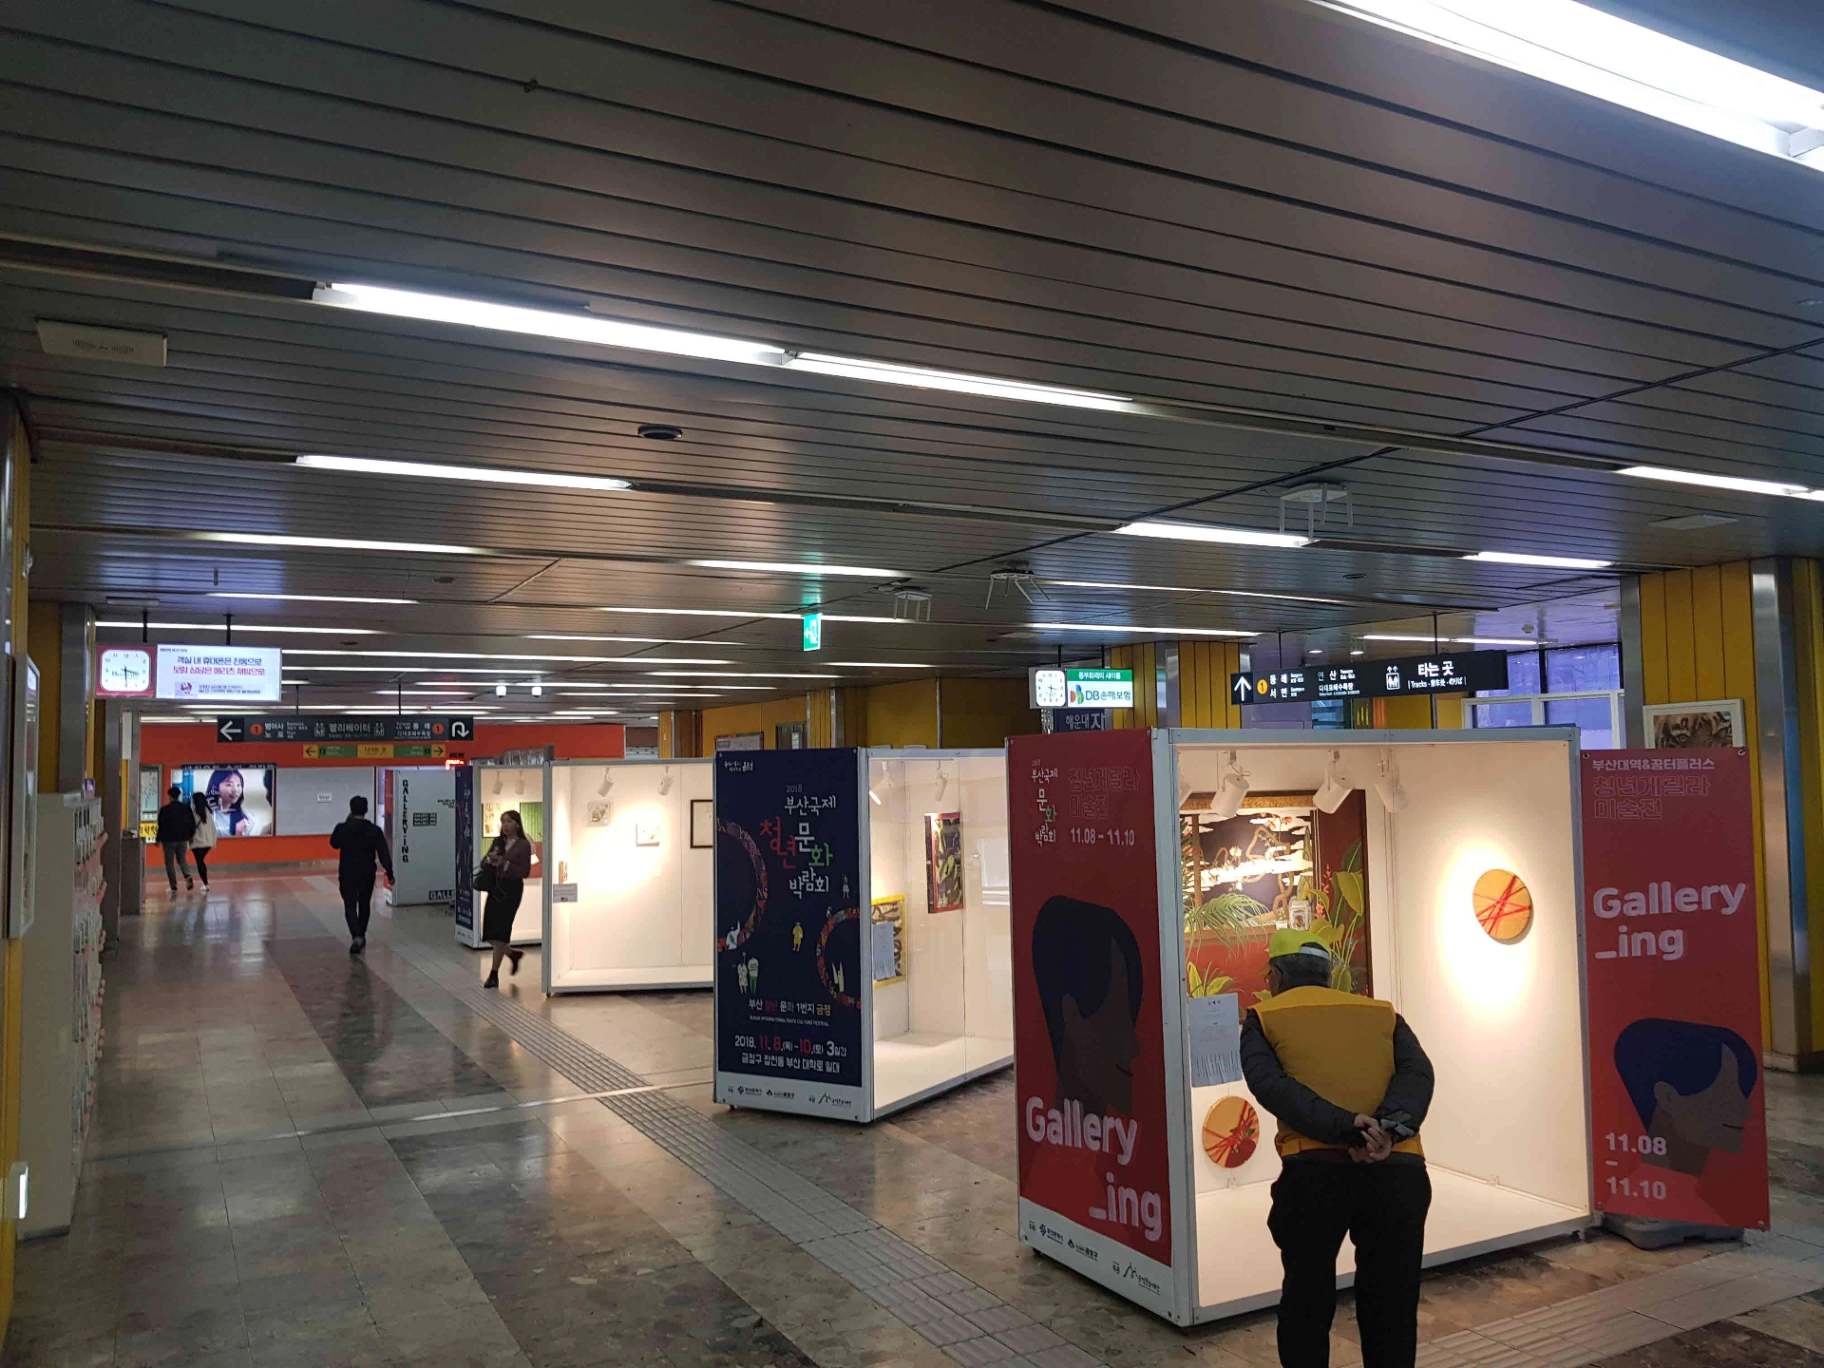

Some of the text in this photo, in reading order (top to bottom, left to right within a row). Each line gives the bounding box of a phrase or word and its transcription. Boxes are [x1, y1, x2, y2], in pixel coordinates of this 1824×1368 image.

[1418, 660, 1454, 678] 타는 곳
[328, 723, 370, 733] 엘리베이터
[1032, 768, 1058, 784] 부산국제
[1593, 775, 1711, 797] 청년게릴라
[786, 784, 803, 793] 2018
[784, 795, 836, 816] 부산국제
[1594, 798, 1663, 820] 미술전
[1070, 828, 1096, 845] 11.08
[1107, 829, 1134, 846] 11.10
[789, 868, 829, 900] 박람회
[1592, 881, 1746, 919] Gallery
[1594, 925, 1684, 961] _ing
[748, 999, 764, 1011] 부산
[796, 1002, 815, 1016] 1번지
[816, 1004, 831, 1016] 금정
[826, 1040, 847, 1056] 3일간
[1026, 1096, 1138, 1166] Gallery
[1605, 1132, 1667, 1156] 11.08
[1606, 1176, 1666, 1200] 11.10
[1088, 1172, 1162, 1242] _ing
